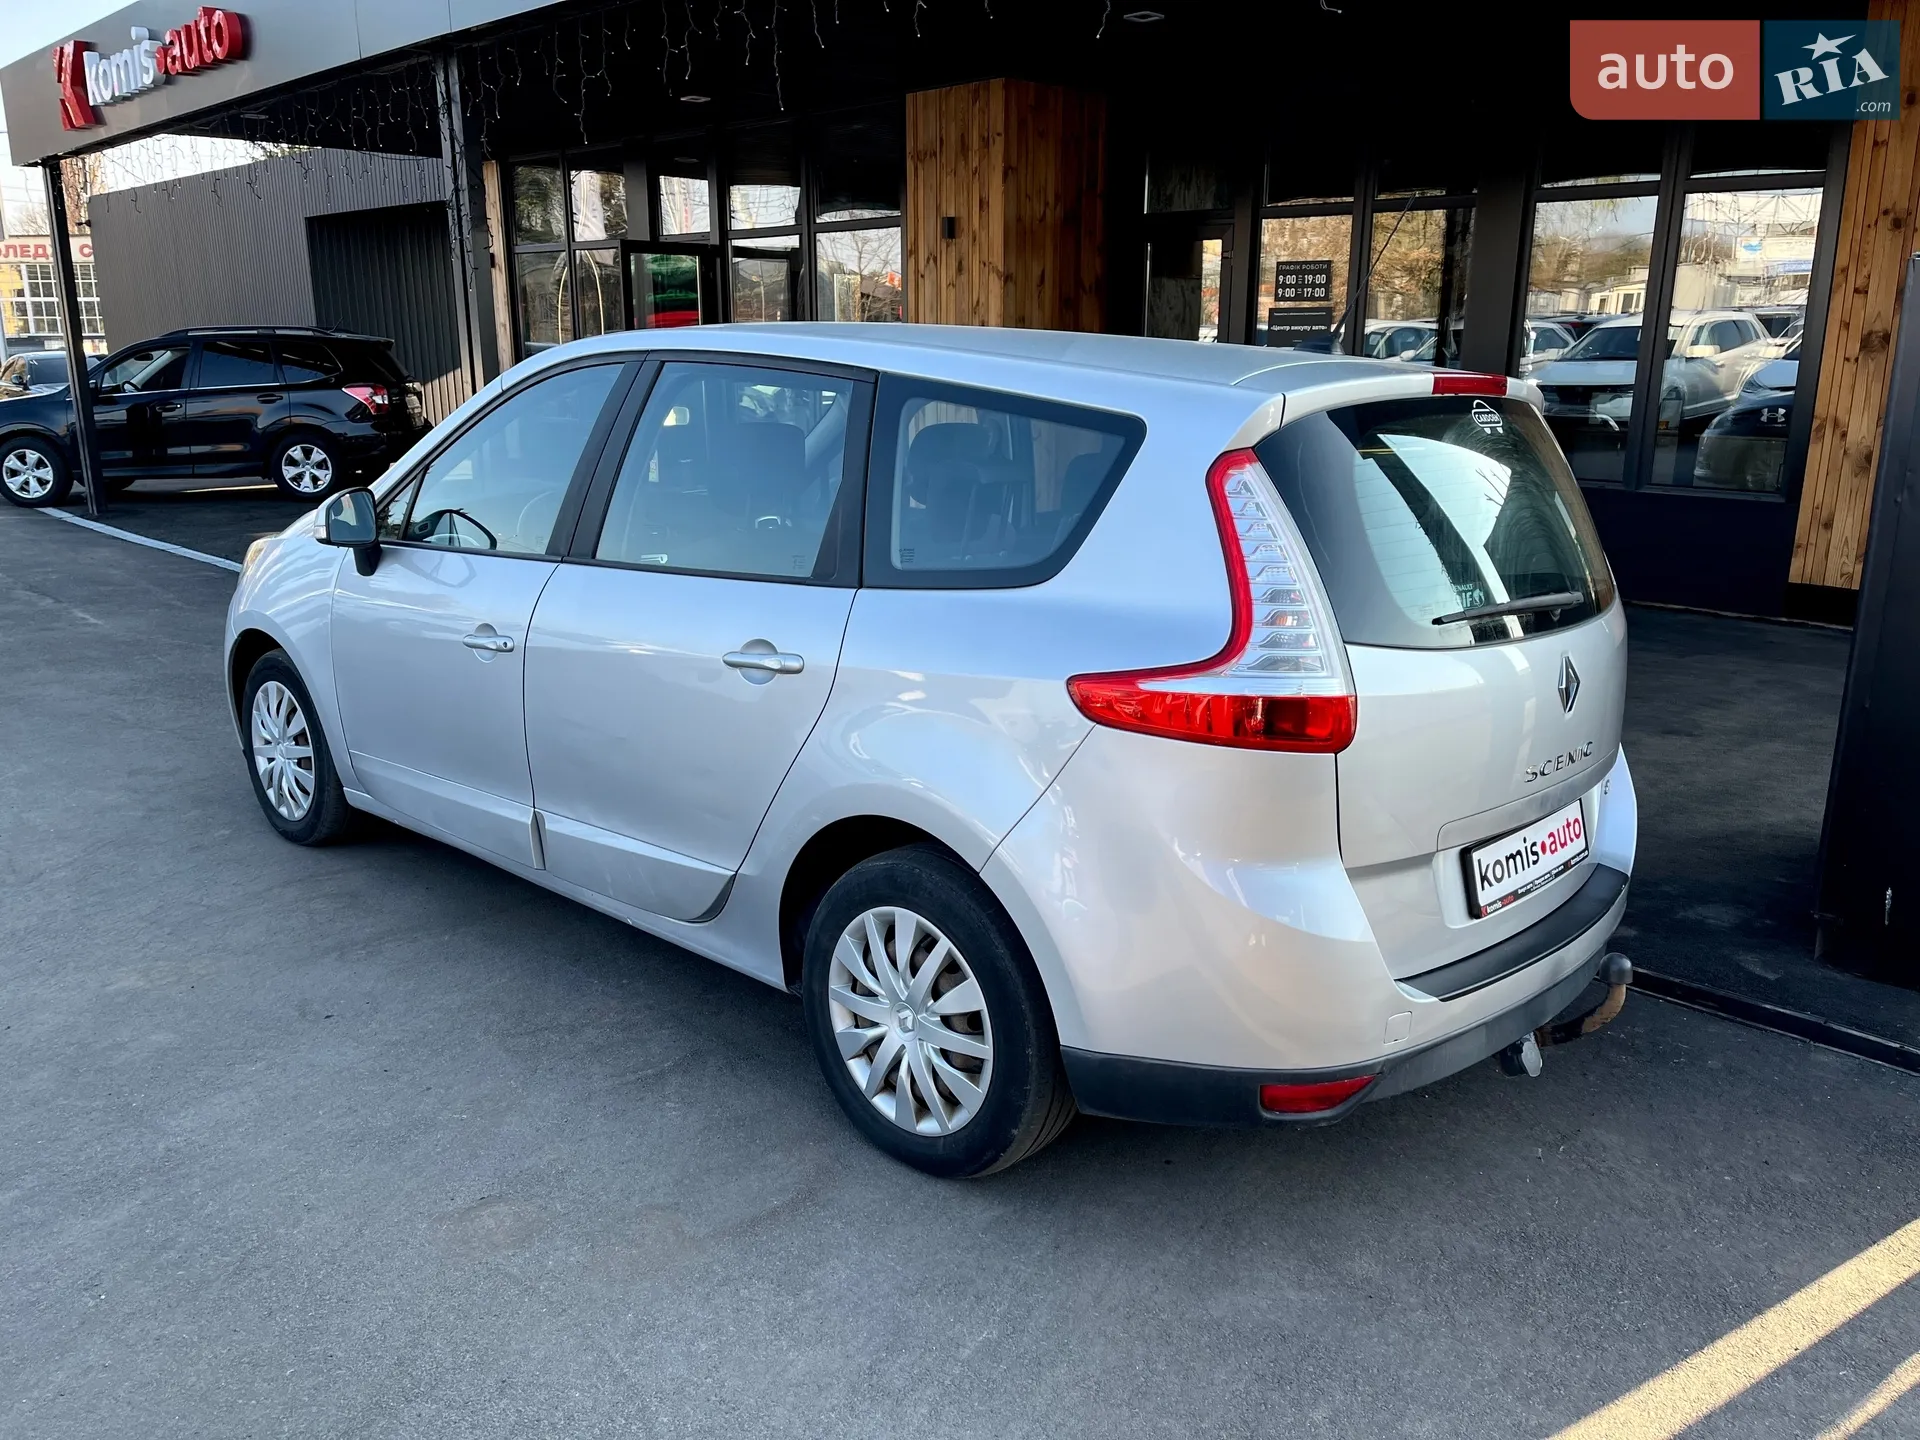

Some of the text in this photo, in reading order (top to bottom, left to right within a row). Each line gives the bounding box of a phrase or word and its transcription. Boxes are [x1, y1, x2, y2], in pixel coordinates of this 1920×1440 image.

[0, 244, 52, 260] ЛЕД
[1278, 274, 1326, 284] 9:00 19:00
[1277, 287, 1325, 298] 9:00 17:00
[1524, 741, 1593, 783] SCENIC
